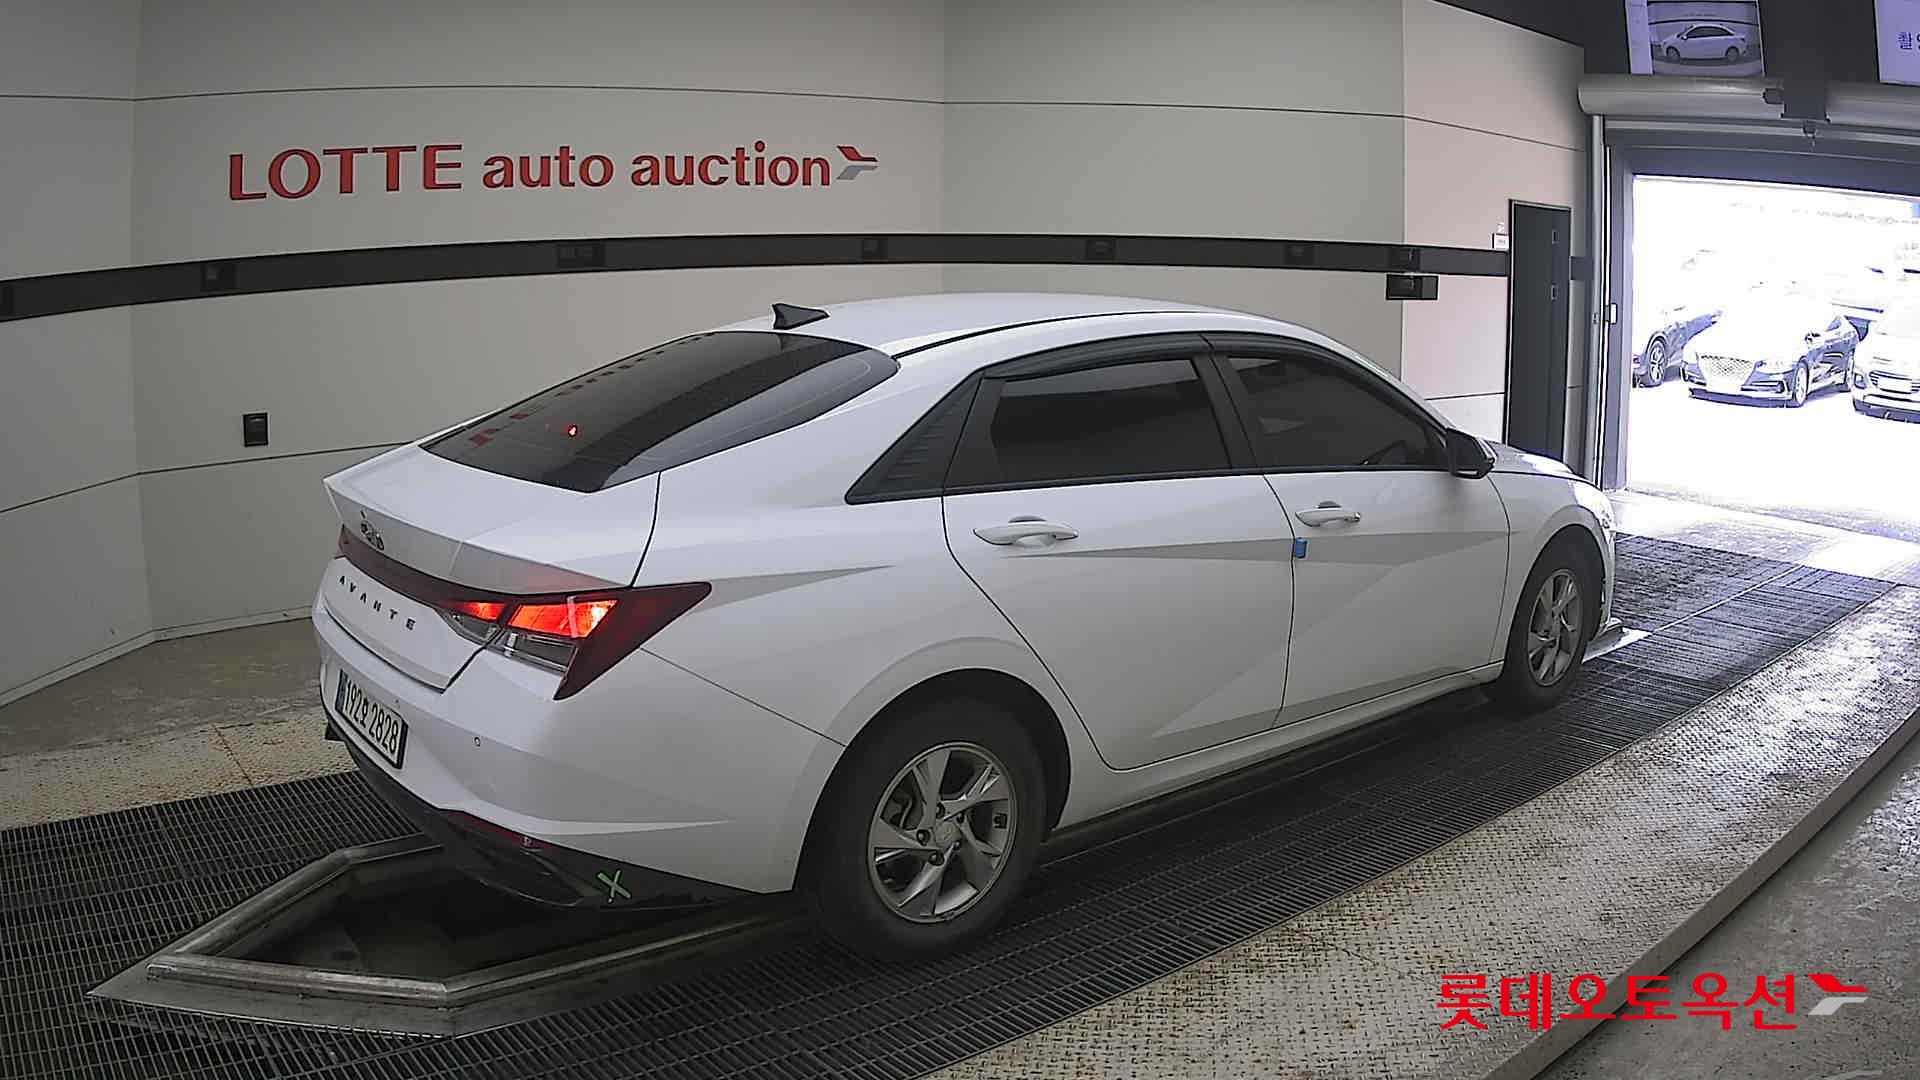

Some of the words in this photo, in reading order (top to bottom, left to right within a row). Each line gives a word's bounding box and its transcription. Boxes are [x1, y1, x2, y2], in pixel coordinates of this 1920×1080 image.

[229, 145, 462, 200] LOTTE
[482, 146, 614, 188] auto
[630, 141, 830, 187] auction
[339, 575, 416, 631] AVANTE
[369, 703, 399, 754] 2828
